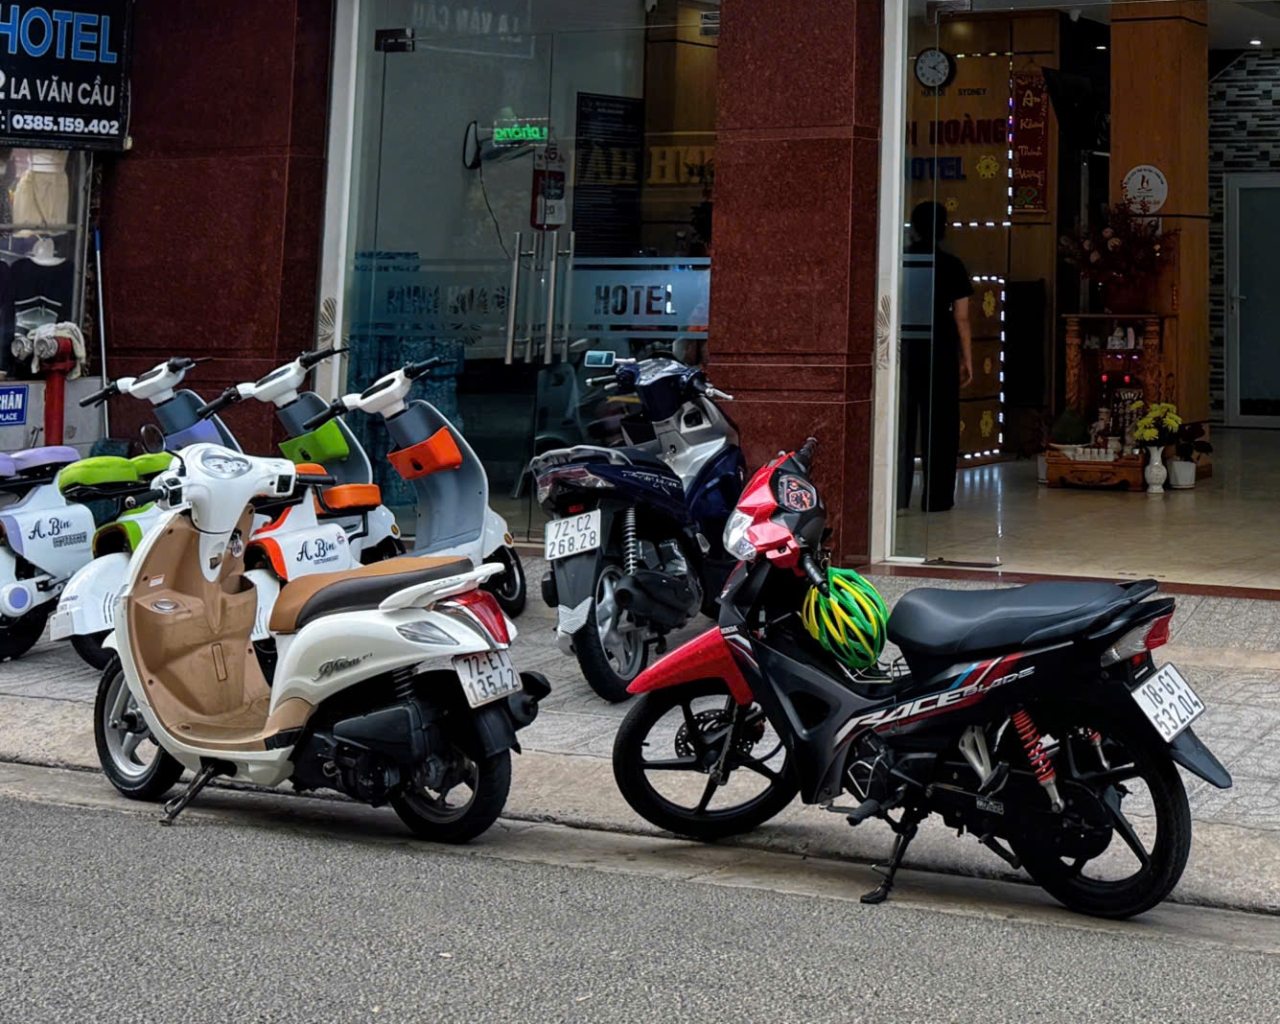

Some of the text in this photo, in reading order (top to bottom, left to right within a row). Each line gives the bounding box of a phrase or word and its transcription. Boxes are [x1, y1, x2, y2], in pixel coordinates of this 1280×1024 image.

[0, 3, 118, 64] HOTEL
[10, 77, 32, 100] LA
[36, 76, 74, 103] VĂN
[78, 75, 116, 107] CẦU
[12, 114, 119, 135] 0385.159.402
[594, 284, 678, 315] HOTEL
[0, 390, 23, 410] HÂN
[554, 514, 592, 539] 72-C2
[548, 530, 597, 558] 268.28
[1141, 669, 1181, 710] 18-G1
[834, 666, 1036, 748] RACE BLADE
[1153, 688, 1202, 736] 532.04
